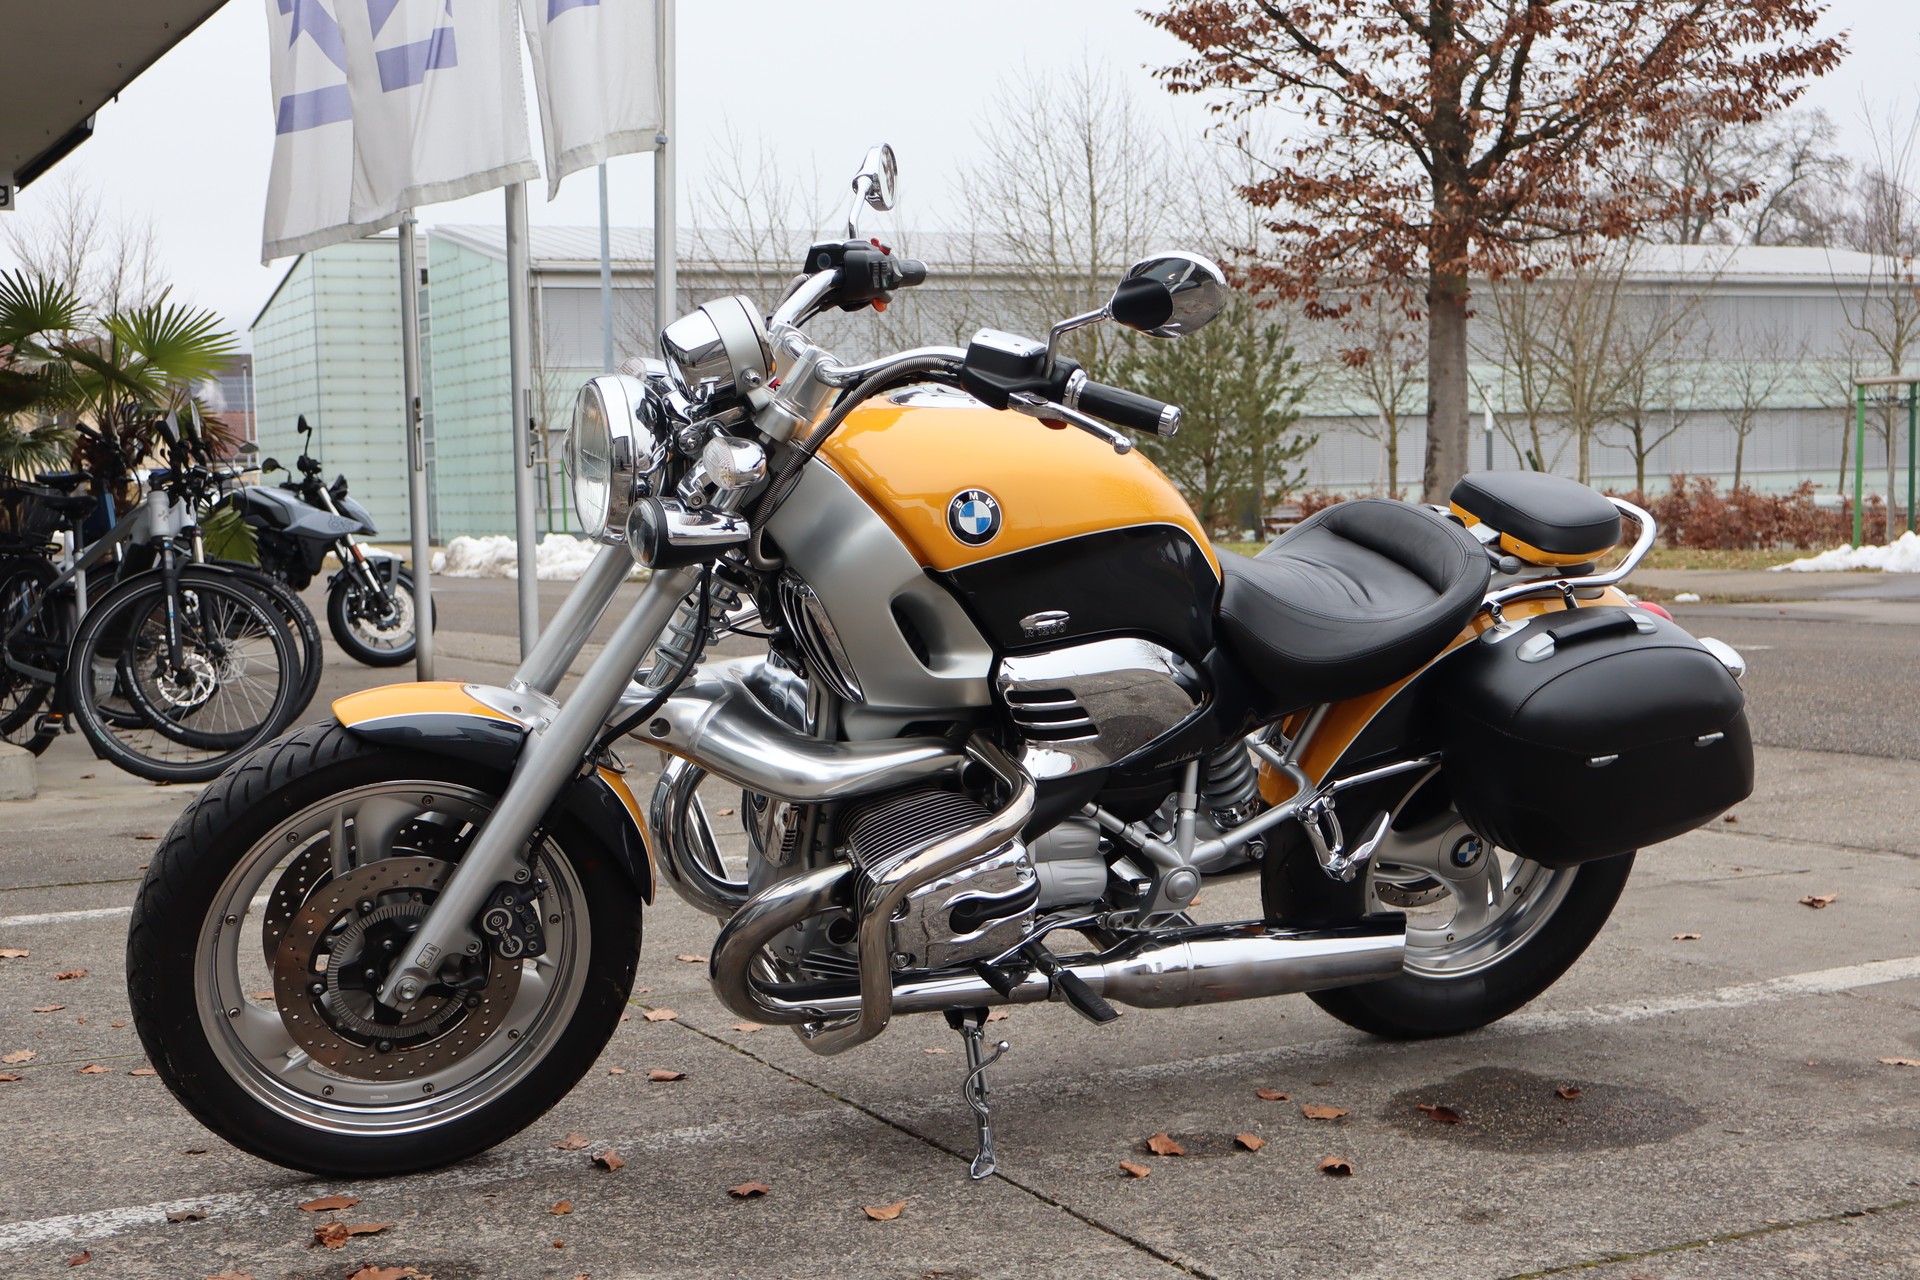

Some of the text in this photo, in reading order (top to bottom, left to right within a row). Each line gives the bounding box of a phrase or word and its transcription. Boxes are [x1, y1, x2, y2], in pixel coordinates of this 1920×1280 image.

[953, 491, 995, 509] BMW
[1025, 621, 1066, 638] R 1200
[499, 925, 515, 952] brembo
